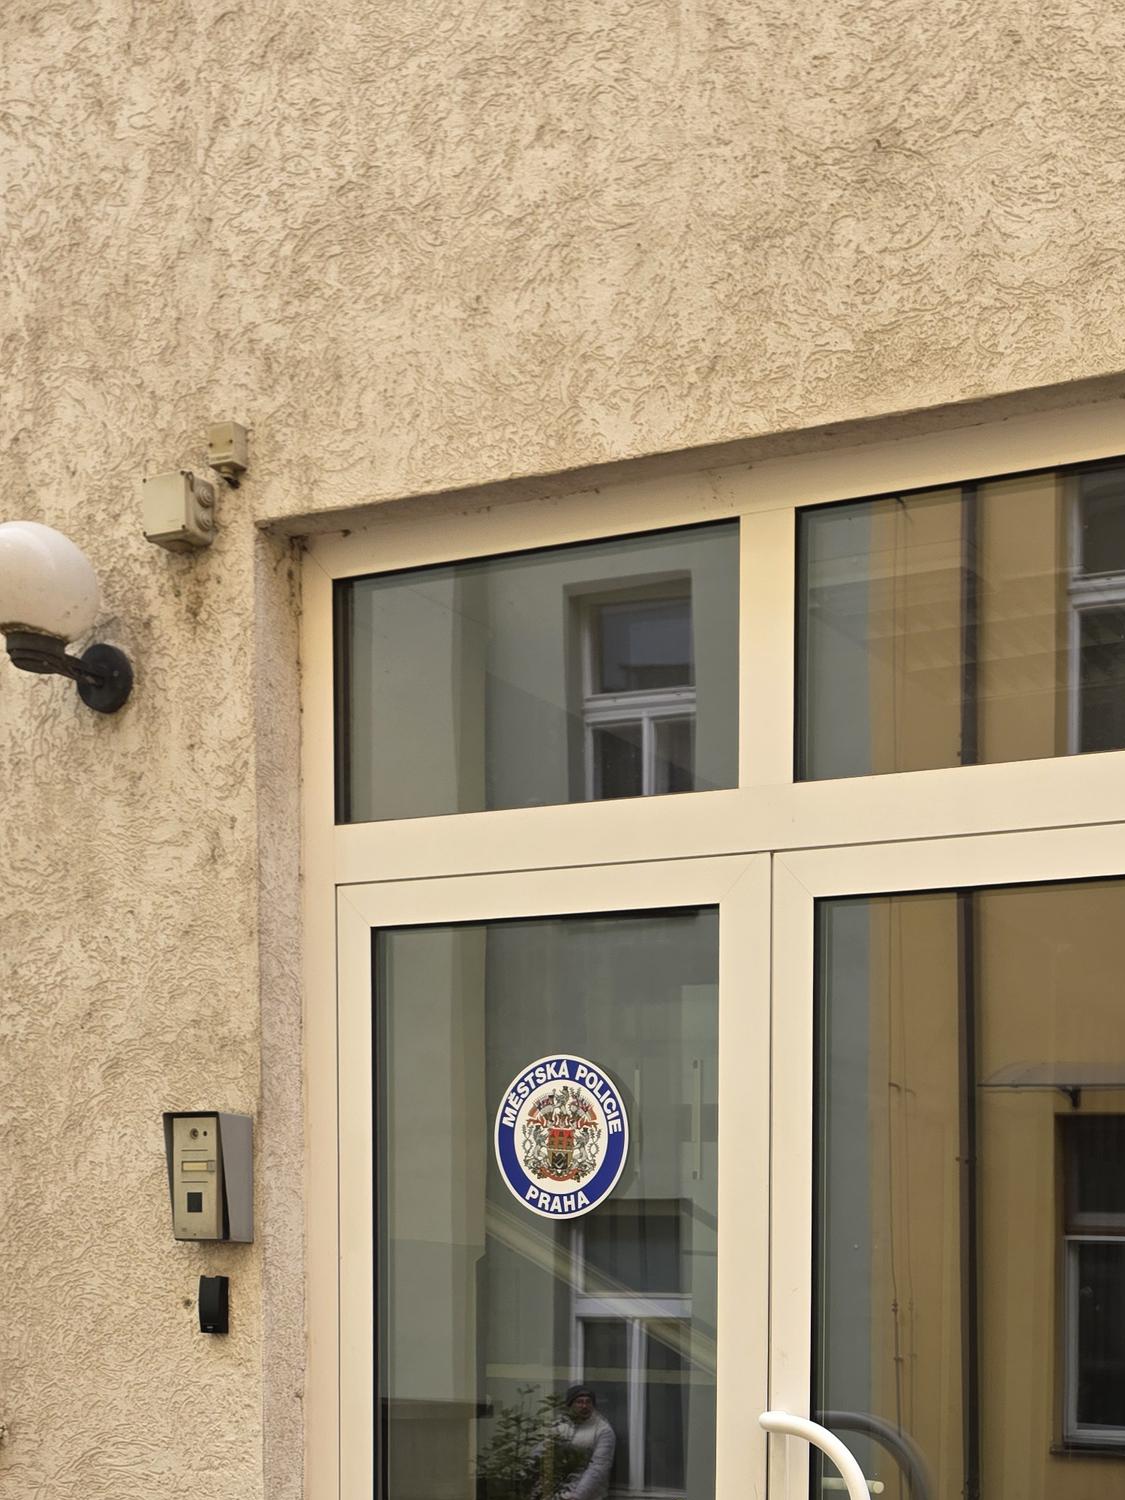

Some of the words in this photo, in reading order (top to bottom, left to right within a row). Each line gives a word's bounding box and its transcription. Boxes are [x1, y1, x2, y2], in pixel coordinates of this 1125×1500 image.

[502, 1060, 570, 1128] MĚSTSKÁ
[575, 1065, 622, 1135] POLICIE
[525, 1185, 590, 1213] PRAHA
